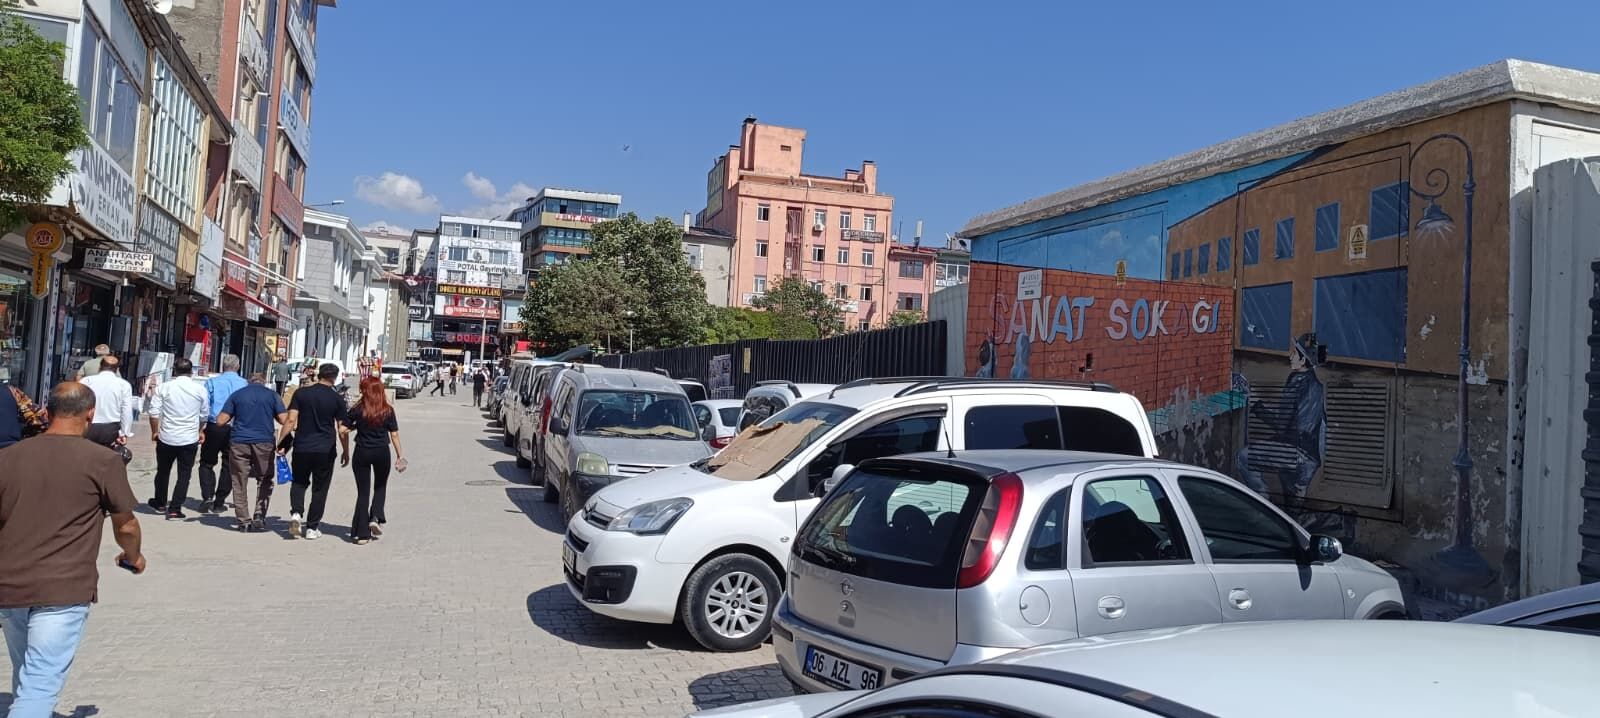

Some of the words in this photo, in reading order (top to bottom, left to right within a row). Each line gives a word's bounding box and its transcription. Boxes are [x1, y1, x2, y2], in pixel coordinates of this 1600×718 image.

[80, 148, 134, 216] ANAHTARCI
[98, 193, 119, 225] ERKAN
[87, 249, 152, 261] ANAHTARCI
[94, 256, 144, 267] ERKAN
[989, 293, 1094, 344] SANAT
[812, 652, 825, 673] 06
[831, 659, 851, 685] AZL
[860, 670, 877, 690] 96
